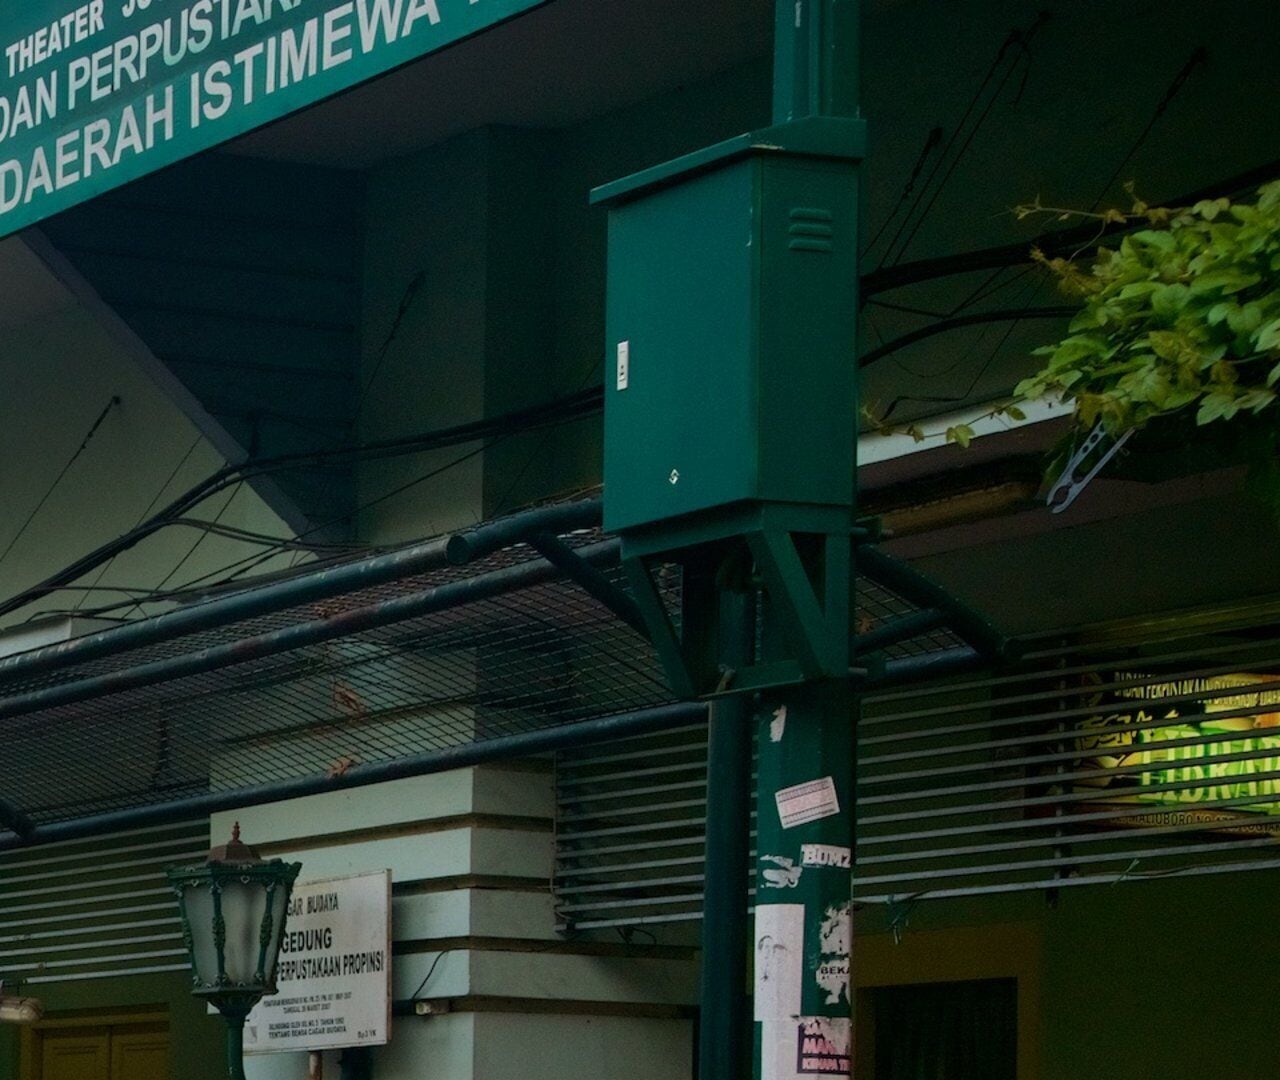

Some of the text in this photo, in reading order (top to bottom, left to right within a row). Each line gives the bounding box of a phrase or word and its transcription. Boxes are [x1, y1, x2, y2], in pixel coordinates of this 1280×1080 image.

[5, 0, 105, 78] THEATER
[190, 0, 441, 129] ISTIMEWA
[307, 892, 340, 915] BUDAYA
[281, 928, 333, 954] GEDUNG
[277, 950, 384, 982] PERPUSTAKAAN PROPINSI
